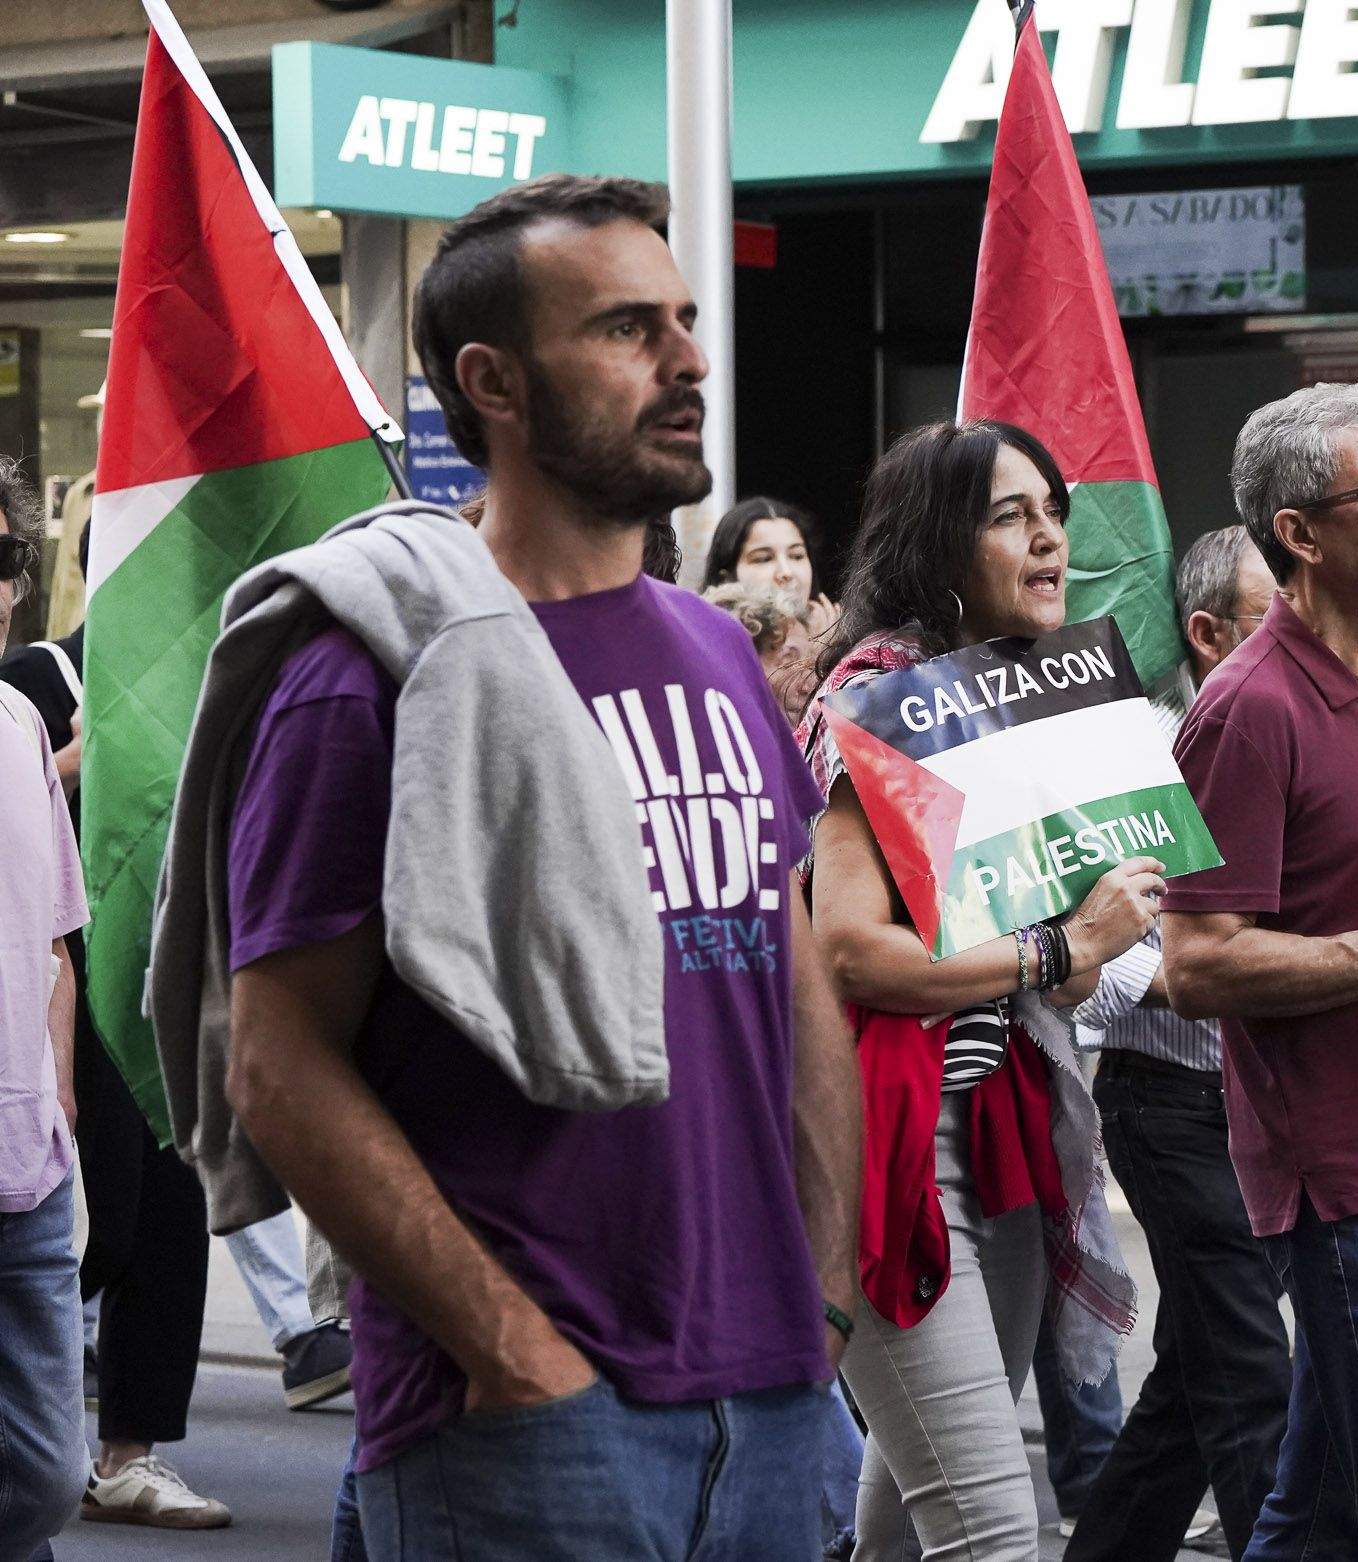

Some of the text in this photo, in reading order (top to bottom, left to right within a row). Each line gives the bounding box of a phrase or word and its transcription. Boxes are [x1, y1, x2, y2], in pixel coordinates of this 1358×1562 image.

[338, 95, 546, 181] ATLEET
[899, 646, 1116, 732] GALIZA CON
[592, 684, 763, 798] ILLO
[973, 810, 1176, 906] PALESTINA
